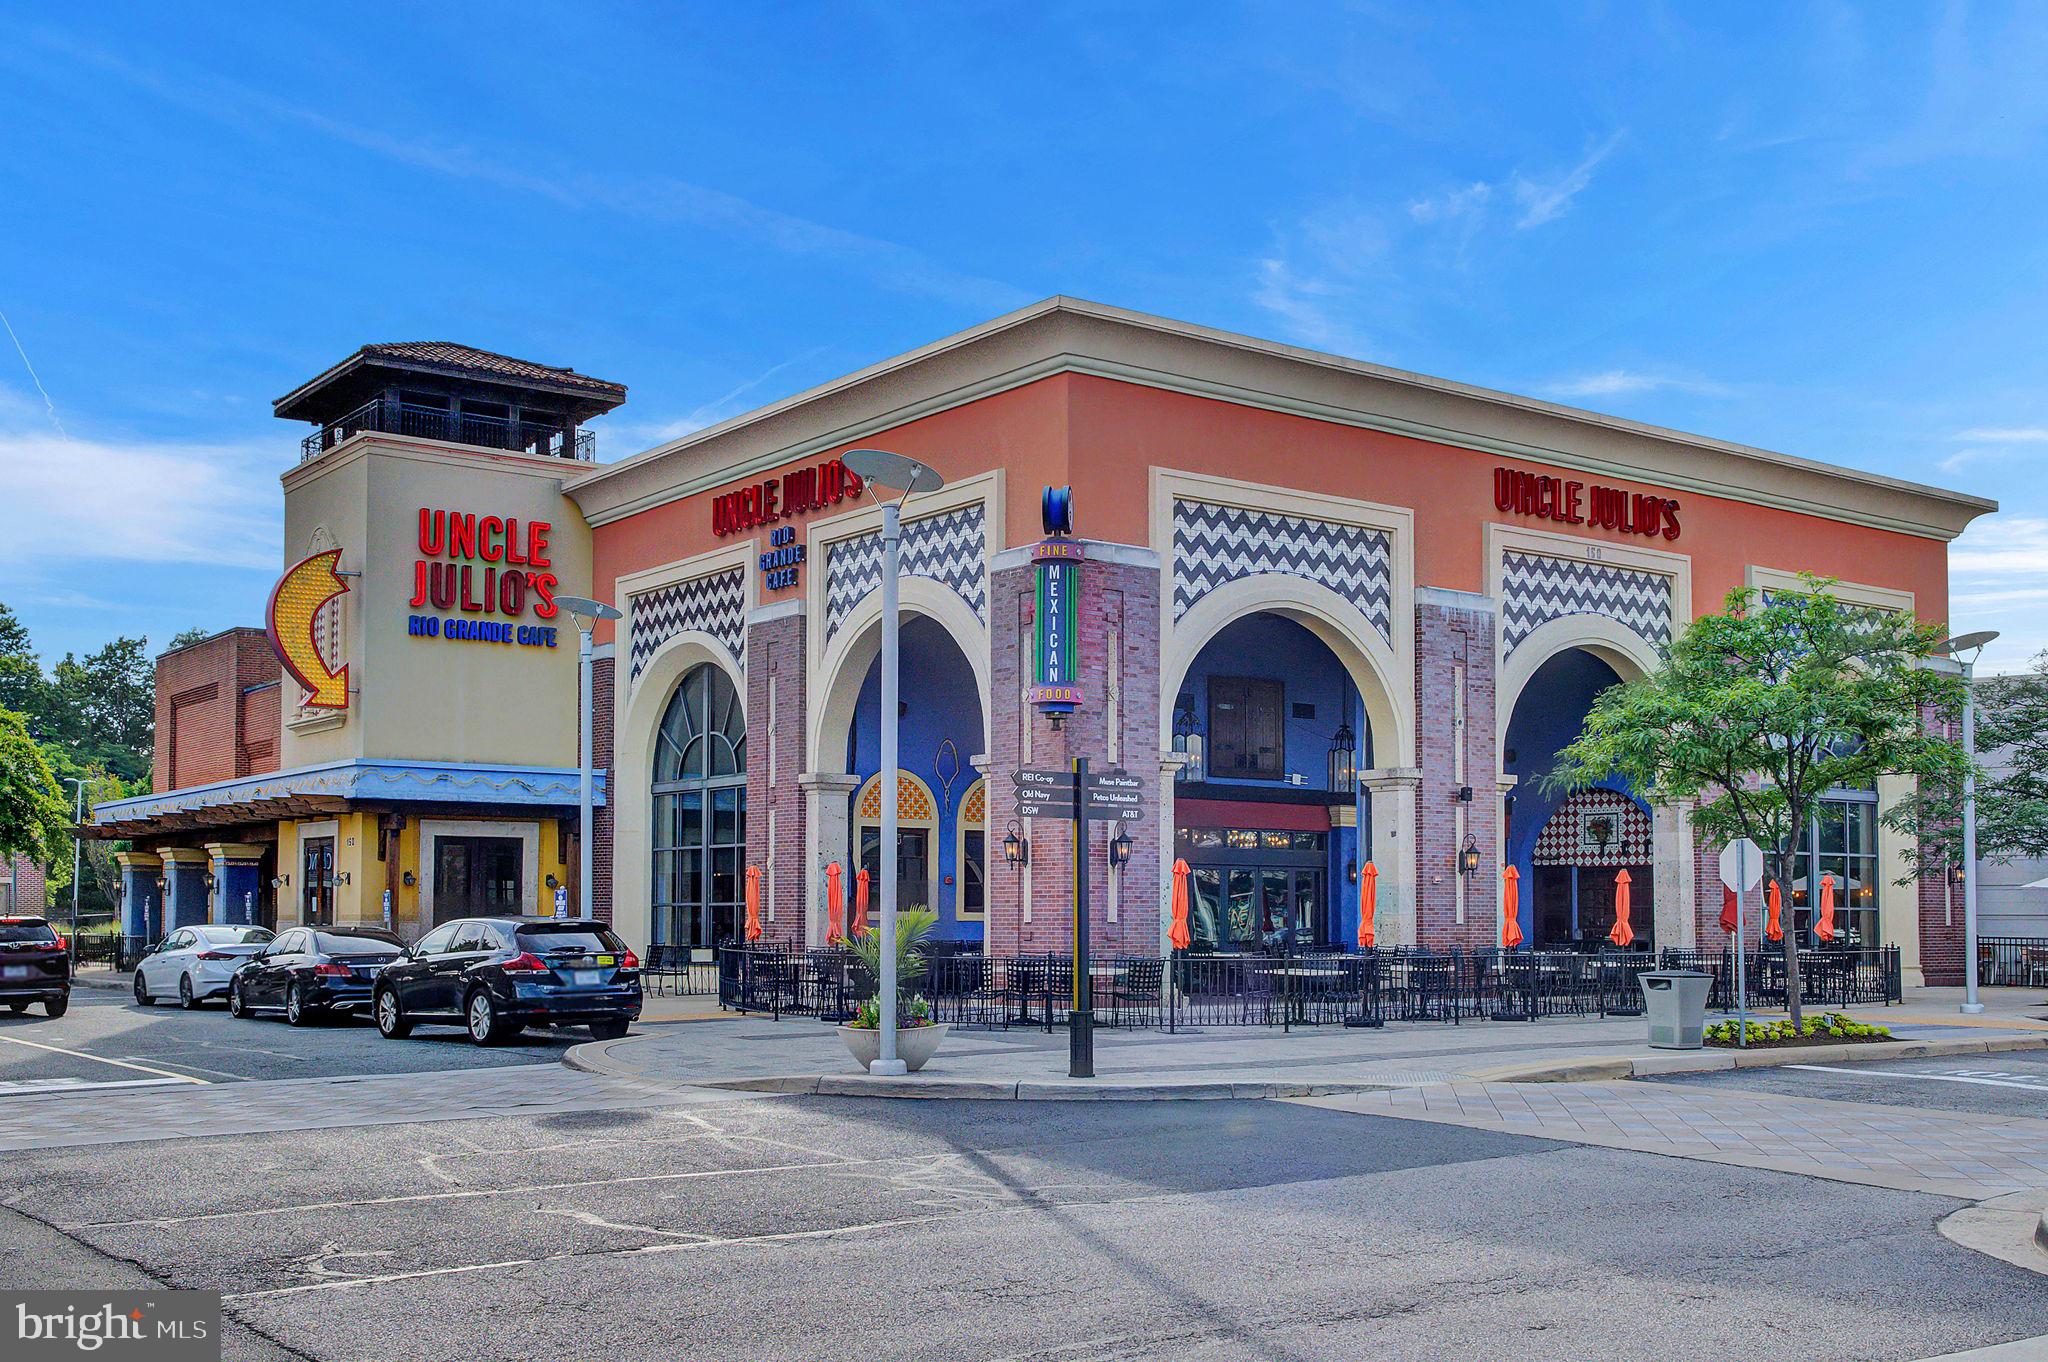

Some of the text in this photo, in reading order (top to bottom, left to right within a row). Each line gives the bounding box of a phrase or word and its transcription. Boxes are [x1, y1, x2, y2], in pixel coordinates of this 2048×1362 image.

[1494, 467, 1584, 524] UNCLE
[713, 479, 779, 537] UNCLE
[418, 508, 552, 567] UNCLE
[770, 525, 795, 547] RIO
[759, 544, 807, 572] GRANDE
[1039, 543, 1068, 556] FINE
[409, 560, 559, 618] JULIO'S
[765, 567, 798, 591] CAFE
[408, 615, 558, 647] RIO GRANDE CAFE
[1049, 564, 1060, 682] MEXICAN
[1038, 687, 1071, 700] FOOD
[1022, 773, 1054, 785] REI Co-op
[1099, 776, 1139, 788] Muse Paintbar
[1022, 790, 1050, 801] Old Navy
[1093, 792, 1138, 803] Petco Unleashed
[1022, 805, 1039, 815] DSW
[1122, 809, 1138, 818] AT&T
